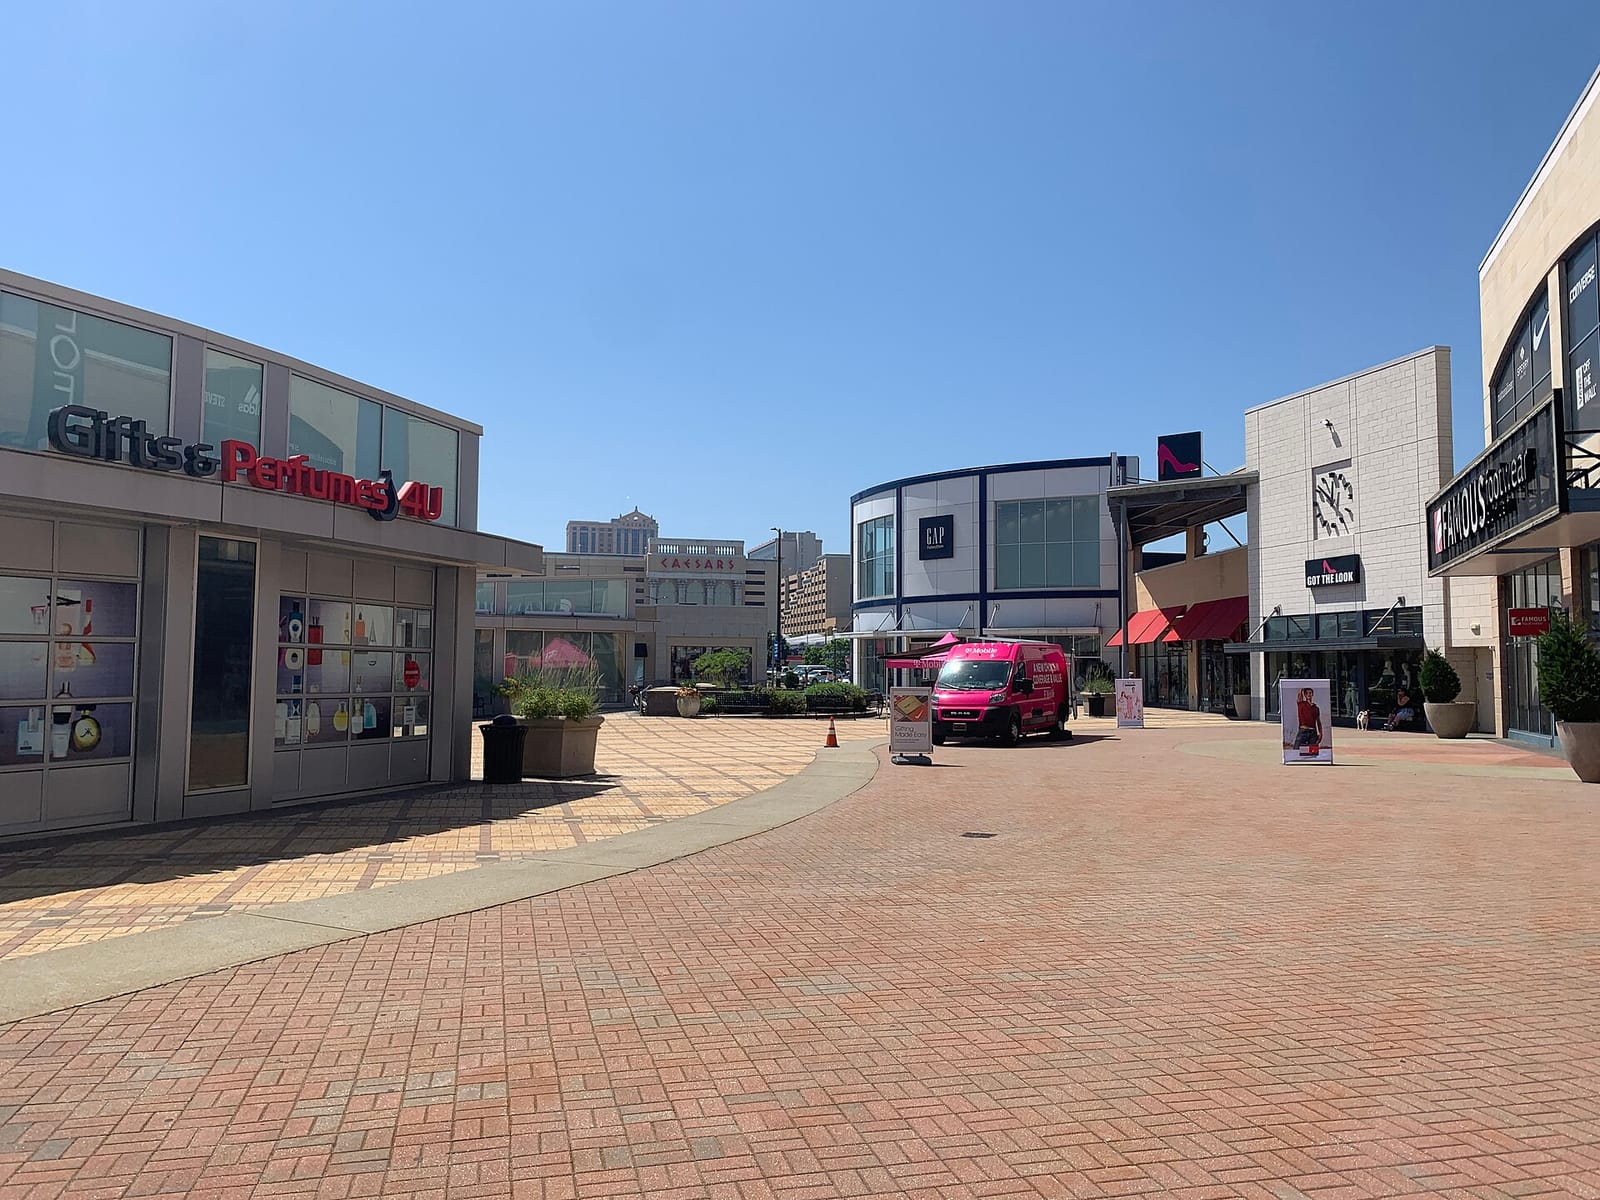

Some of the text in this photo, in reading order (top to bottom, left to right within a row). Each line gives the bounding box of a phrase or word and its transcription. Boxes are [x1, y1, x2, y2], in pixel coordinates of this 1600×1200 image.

[1569, 264, 1596, 304] CONVERSE
[48, 404, 443, 520] Gifts & Perfumes 4U
[1442, 475, 1486, 550] FAMOUS
[926, 527, 945, 545] GAP
[661, 558, 735, 569] CAESARS
[1307, 571, 1354, 586] GOT THE LOOK
